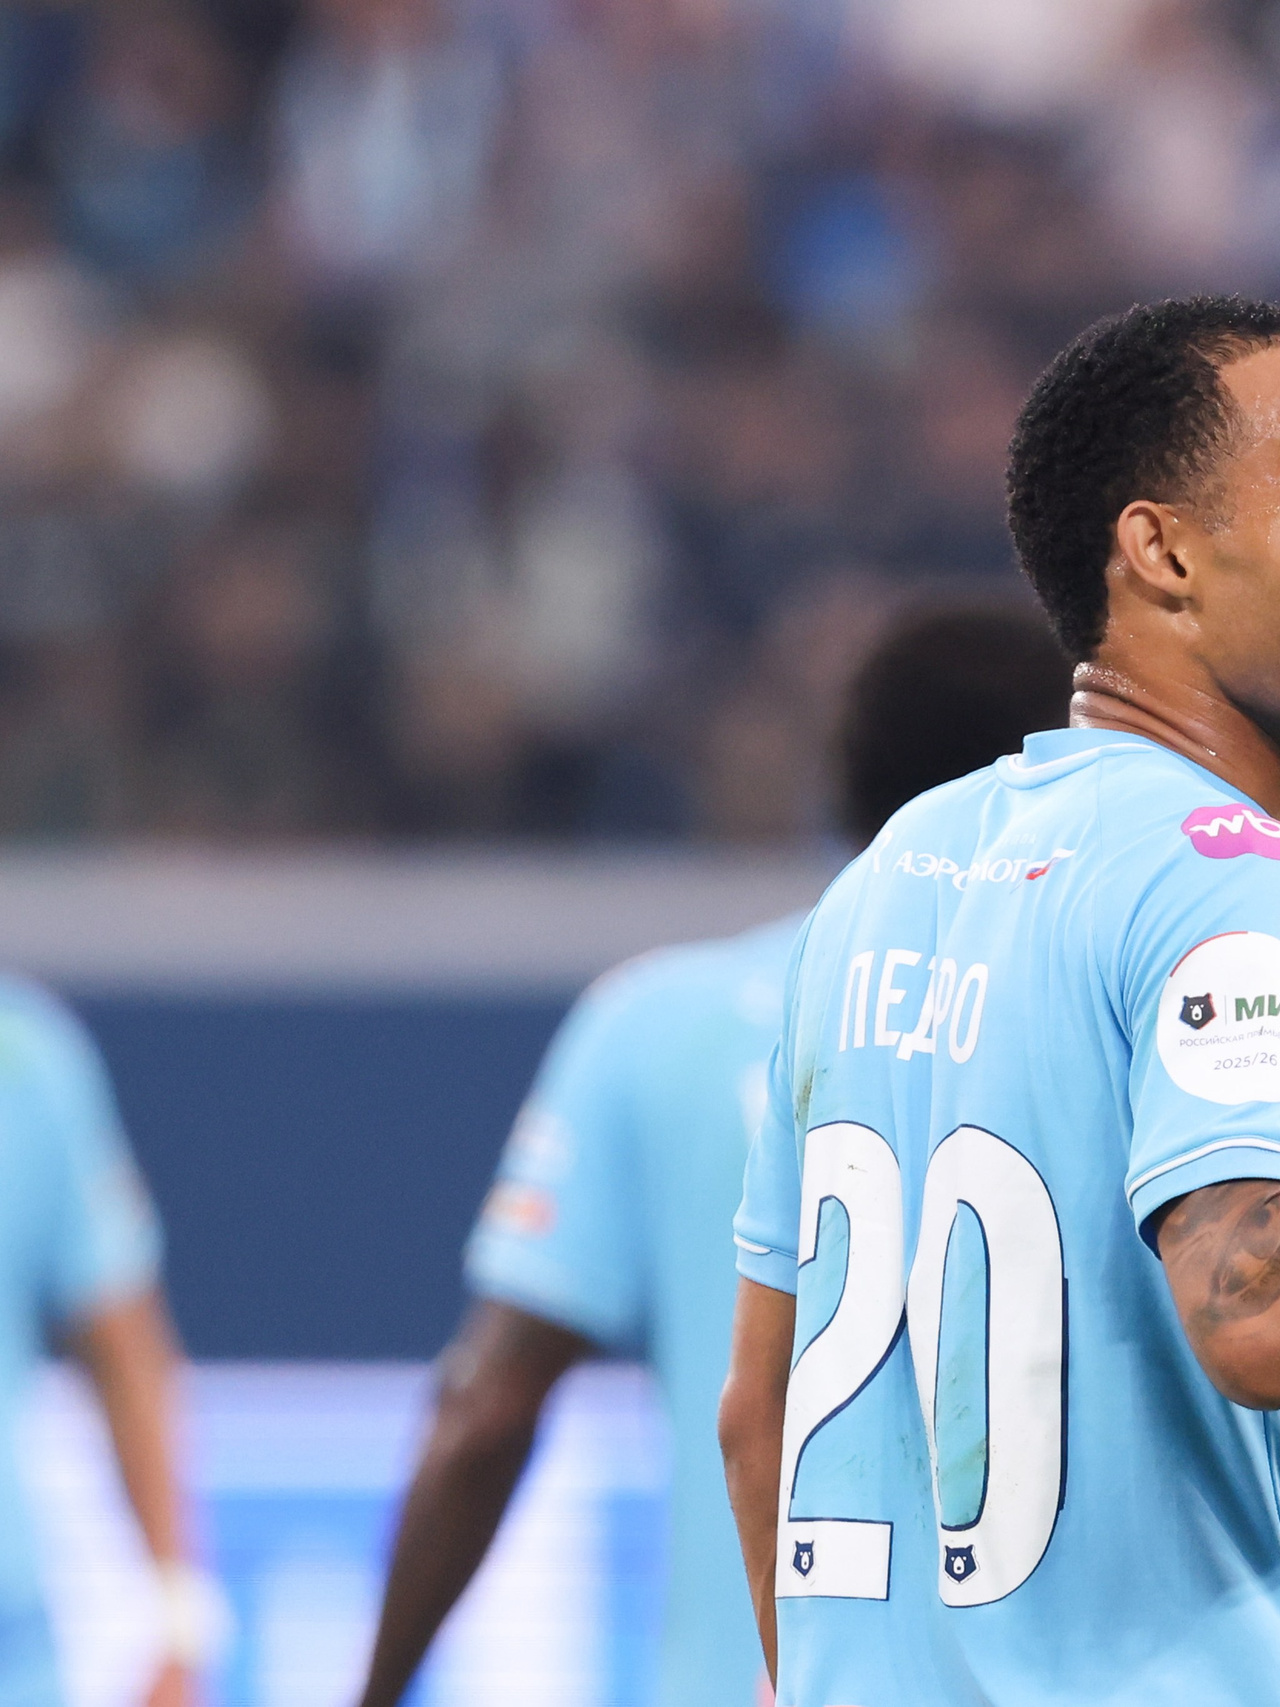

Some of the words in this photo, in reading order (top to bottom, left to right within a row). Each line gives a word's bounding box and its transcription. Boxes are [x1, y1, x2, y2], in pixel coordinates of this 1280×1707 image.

[838, 948, 989, 1065] ПЕДРО
[1179, 1034, 1245, 1048] РОССИЙСКАЯ
[1213, 1052, 1278, 1071] 2025/26
[775, 1120, 1069, 1608] 20
